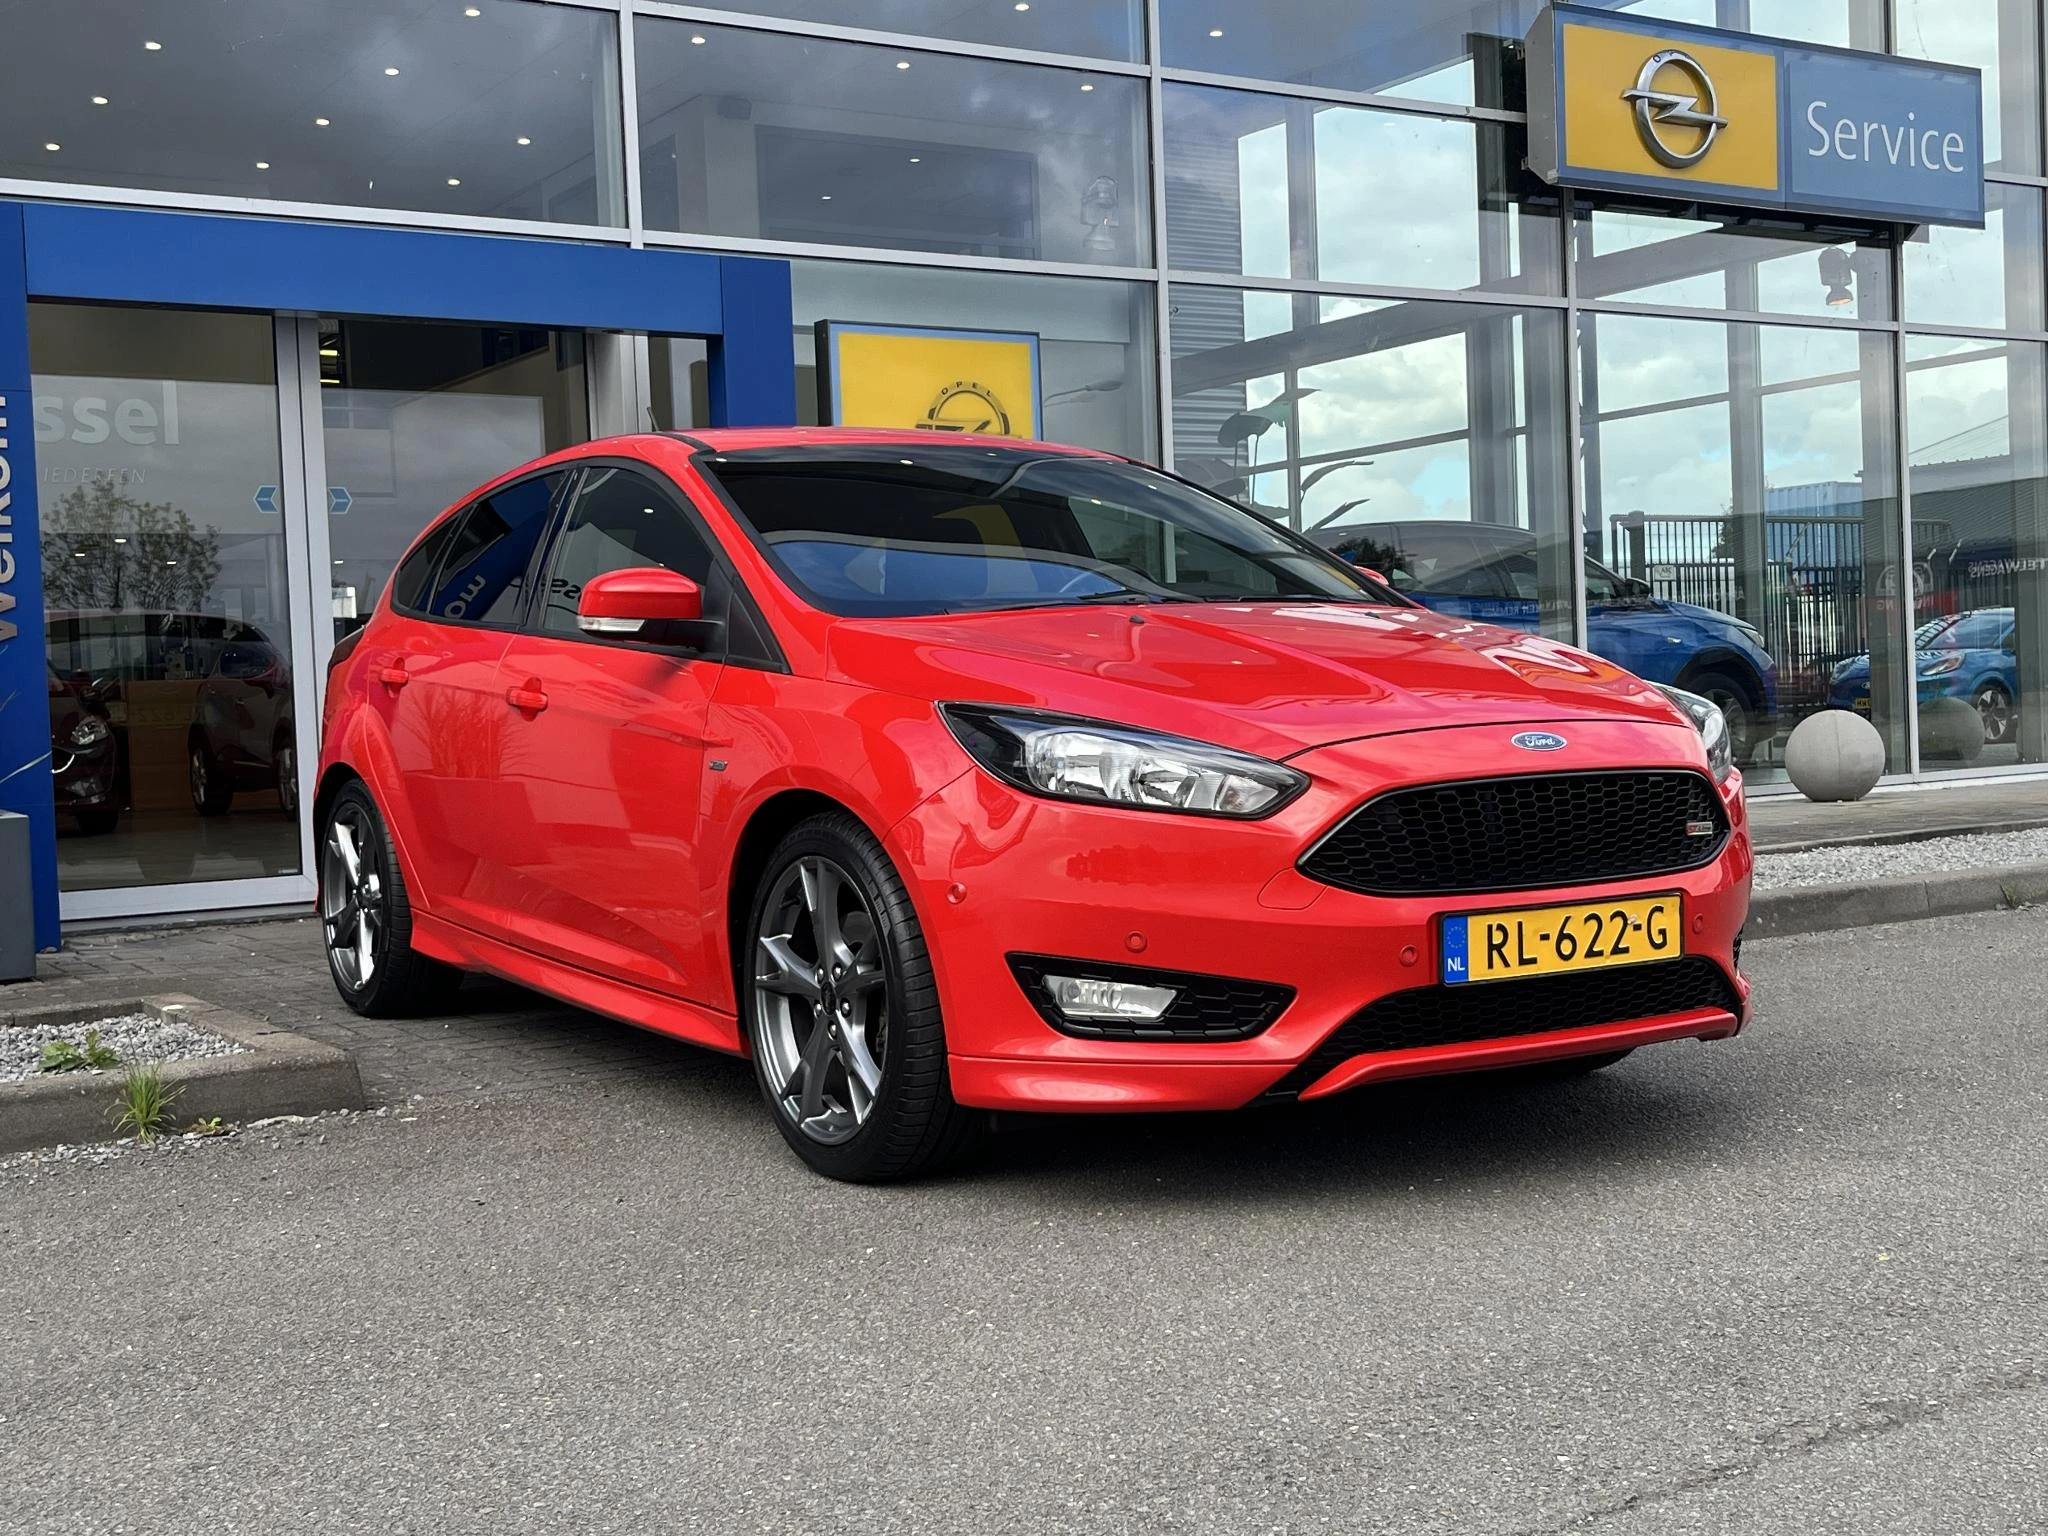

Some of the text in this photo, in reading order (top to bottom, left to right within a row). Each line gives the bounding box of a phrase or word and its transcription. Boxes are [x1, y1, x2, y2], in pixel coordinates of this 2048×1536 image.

[1806, 100, 1965, 173] Service
[941, 380, 993, 397] OPEL
[1524, 735, 1556, 747] Ford
[1486, 904, 1668, 970] RL-622-G
[1447, 956, 1466, 972] NL
